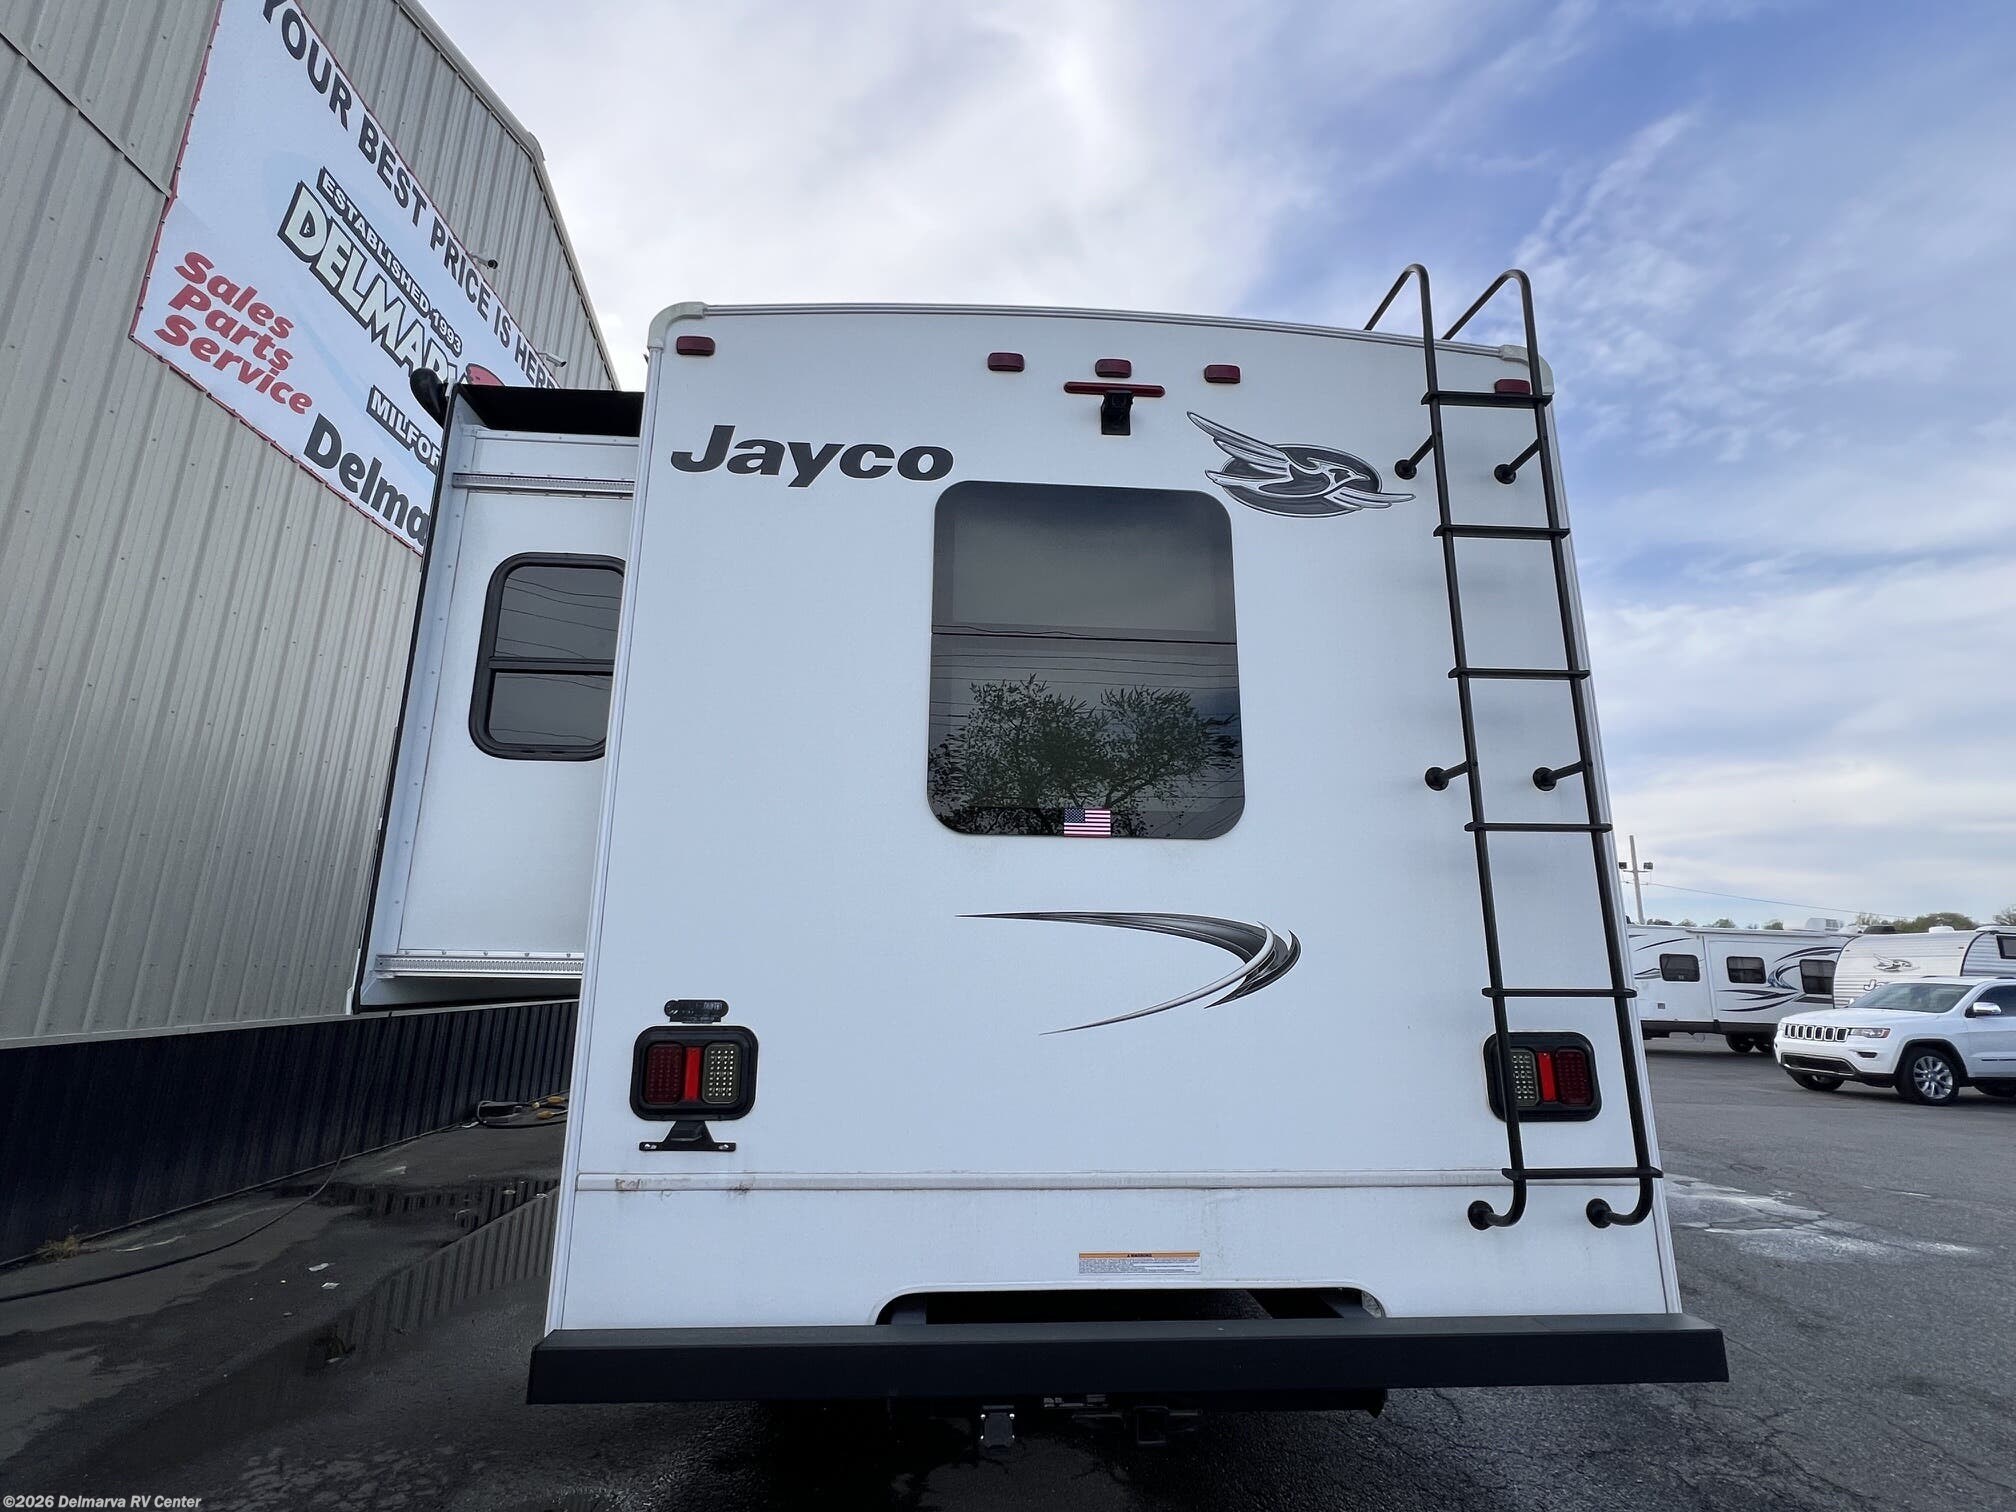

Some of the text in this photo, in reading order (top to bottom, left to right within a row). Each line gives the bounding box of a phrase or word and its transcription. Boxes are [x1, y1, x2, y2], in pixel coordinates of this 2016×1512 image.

[318, 169, 462, 355] ESTABLISHED 1993
[358, 113, 427, 227] BEST
[430, 216, 491, 321] PRICE
[494, 305, 511, 348] IS
[168, 284, 293, 370] Parts
[174, 252, 294, 338] Sales
[154, 315, 312, 414] Service
[304, 413, 430, 546] Delma
[671, 425, 954, 488] Jayco
